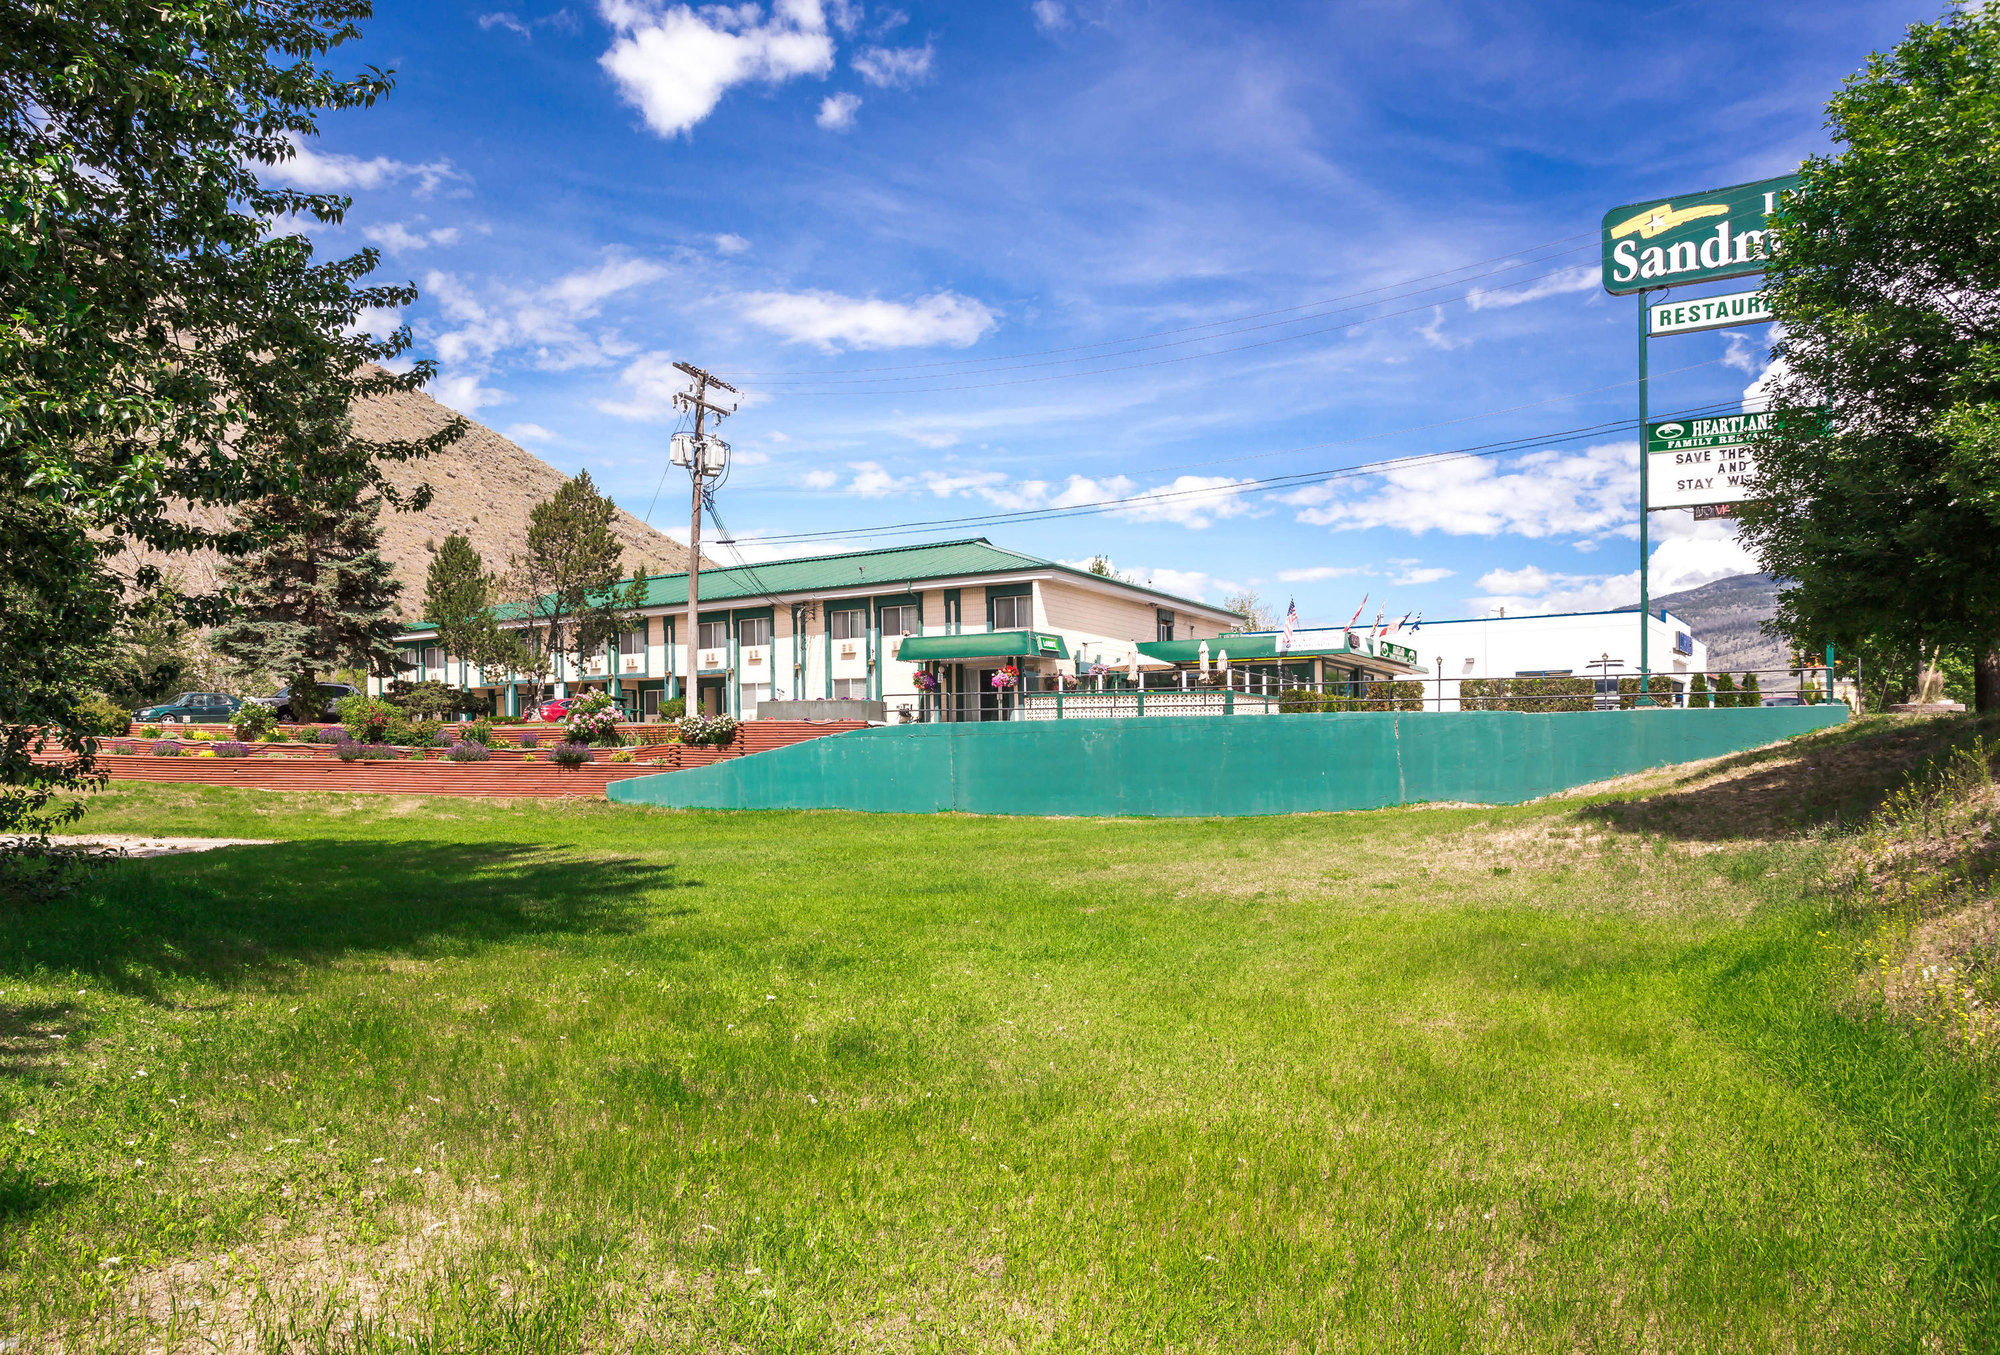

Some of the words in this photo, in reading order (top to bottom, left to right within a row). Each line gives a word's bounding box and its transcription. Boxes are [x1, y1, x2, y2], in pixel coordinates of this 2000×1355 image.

[1613, 221, 1784, 282] Sandm
[1659, 296, 1776, 327] RESTAUR
[1667, 437, 1712, 449] FAMILY
[1676, 450, 1711, 464] SAVE
[1717, 461, 1747, 474] AND
[1677, 477, 1713, 490] STAY
